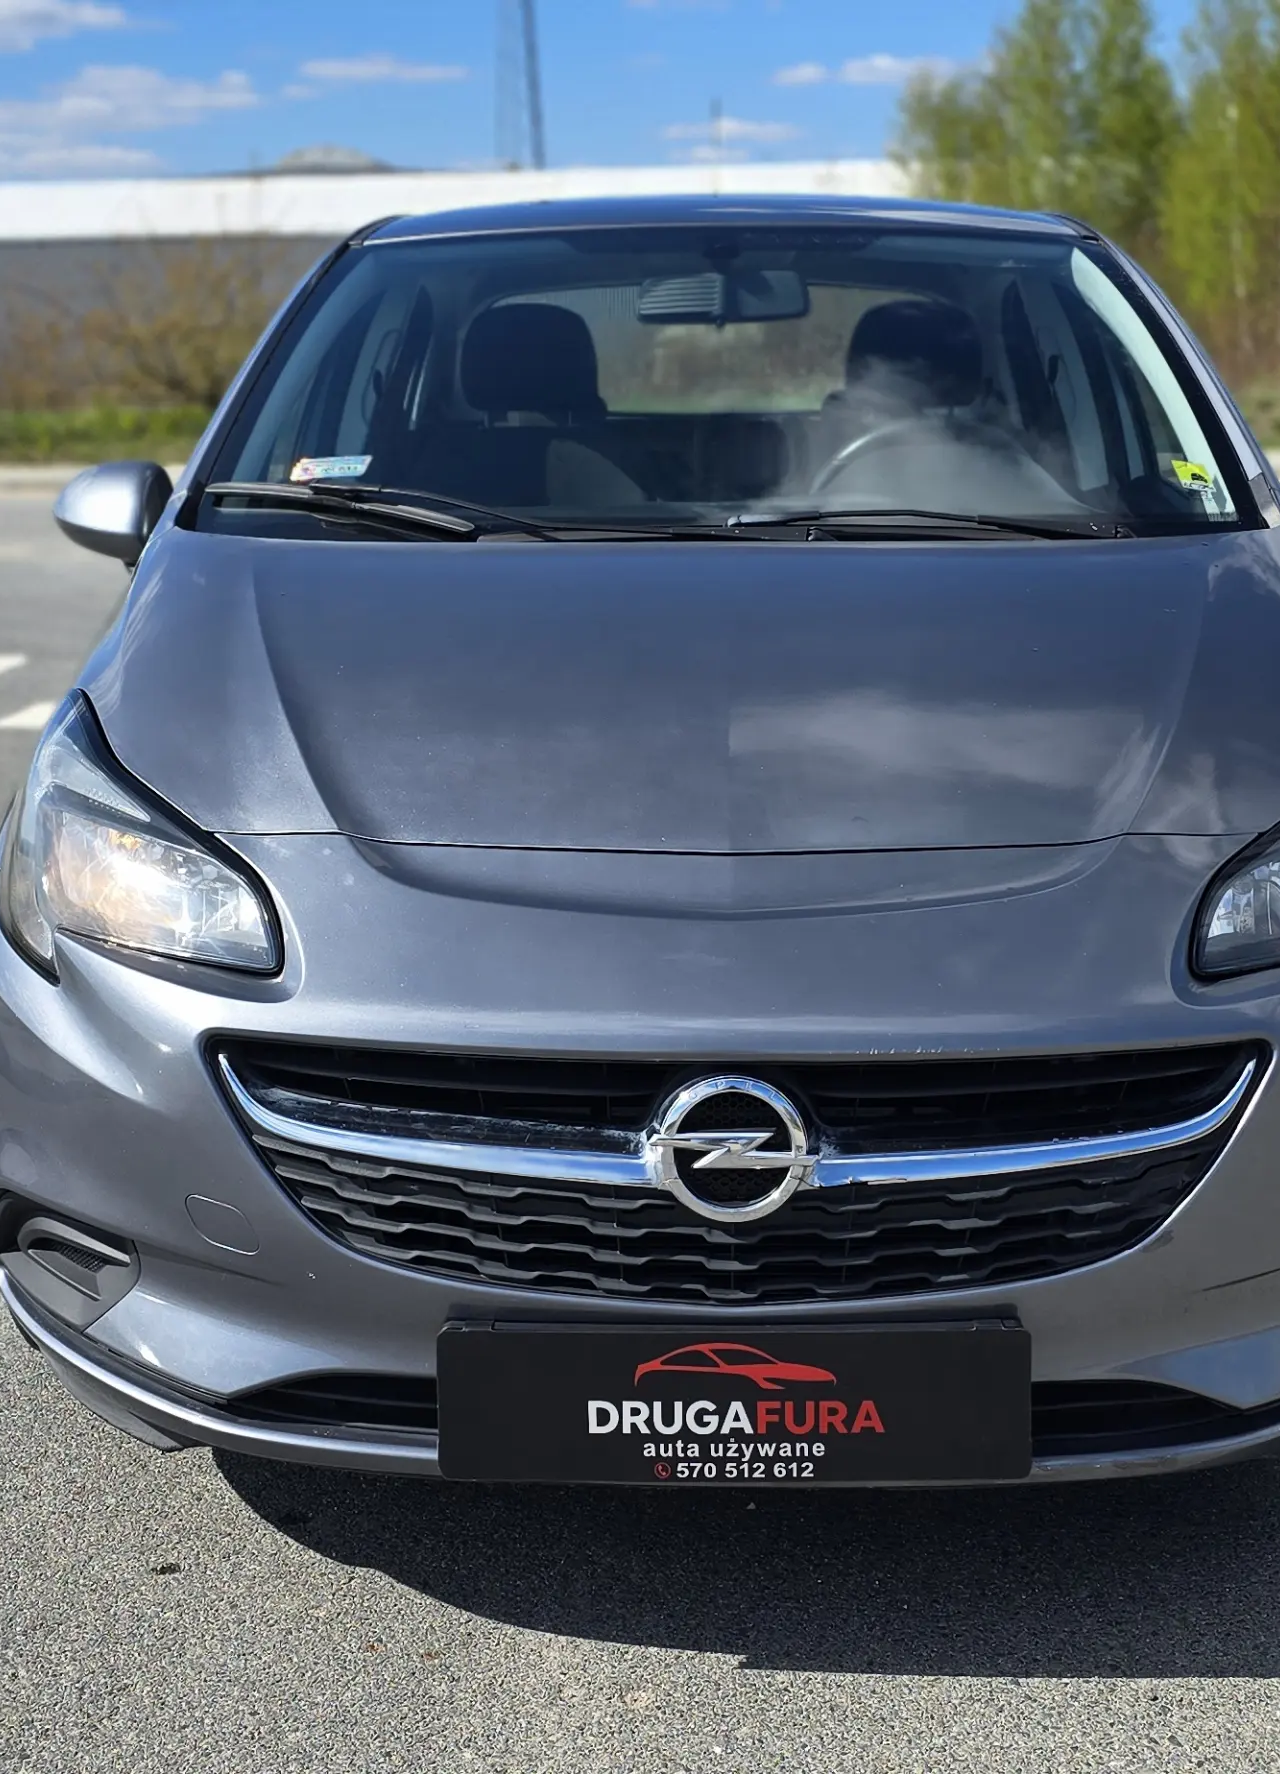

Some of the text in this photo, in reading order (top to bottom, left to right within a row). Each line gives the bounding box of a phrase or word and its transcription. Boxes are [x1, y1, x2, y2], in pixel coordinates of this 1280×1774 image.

[587, 1400, 886, 1435] DRUGAFURA
[643, 1438, 826, 1461] auta używane
[676, 1462, 814, 1478] 570 512 612
